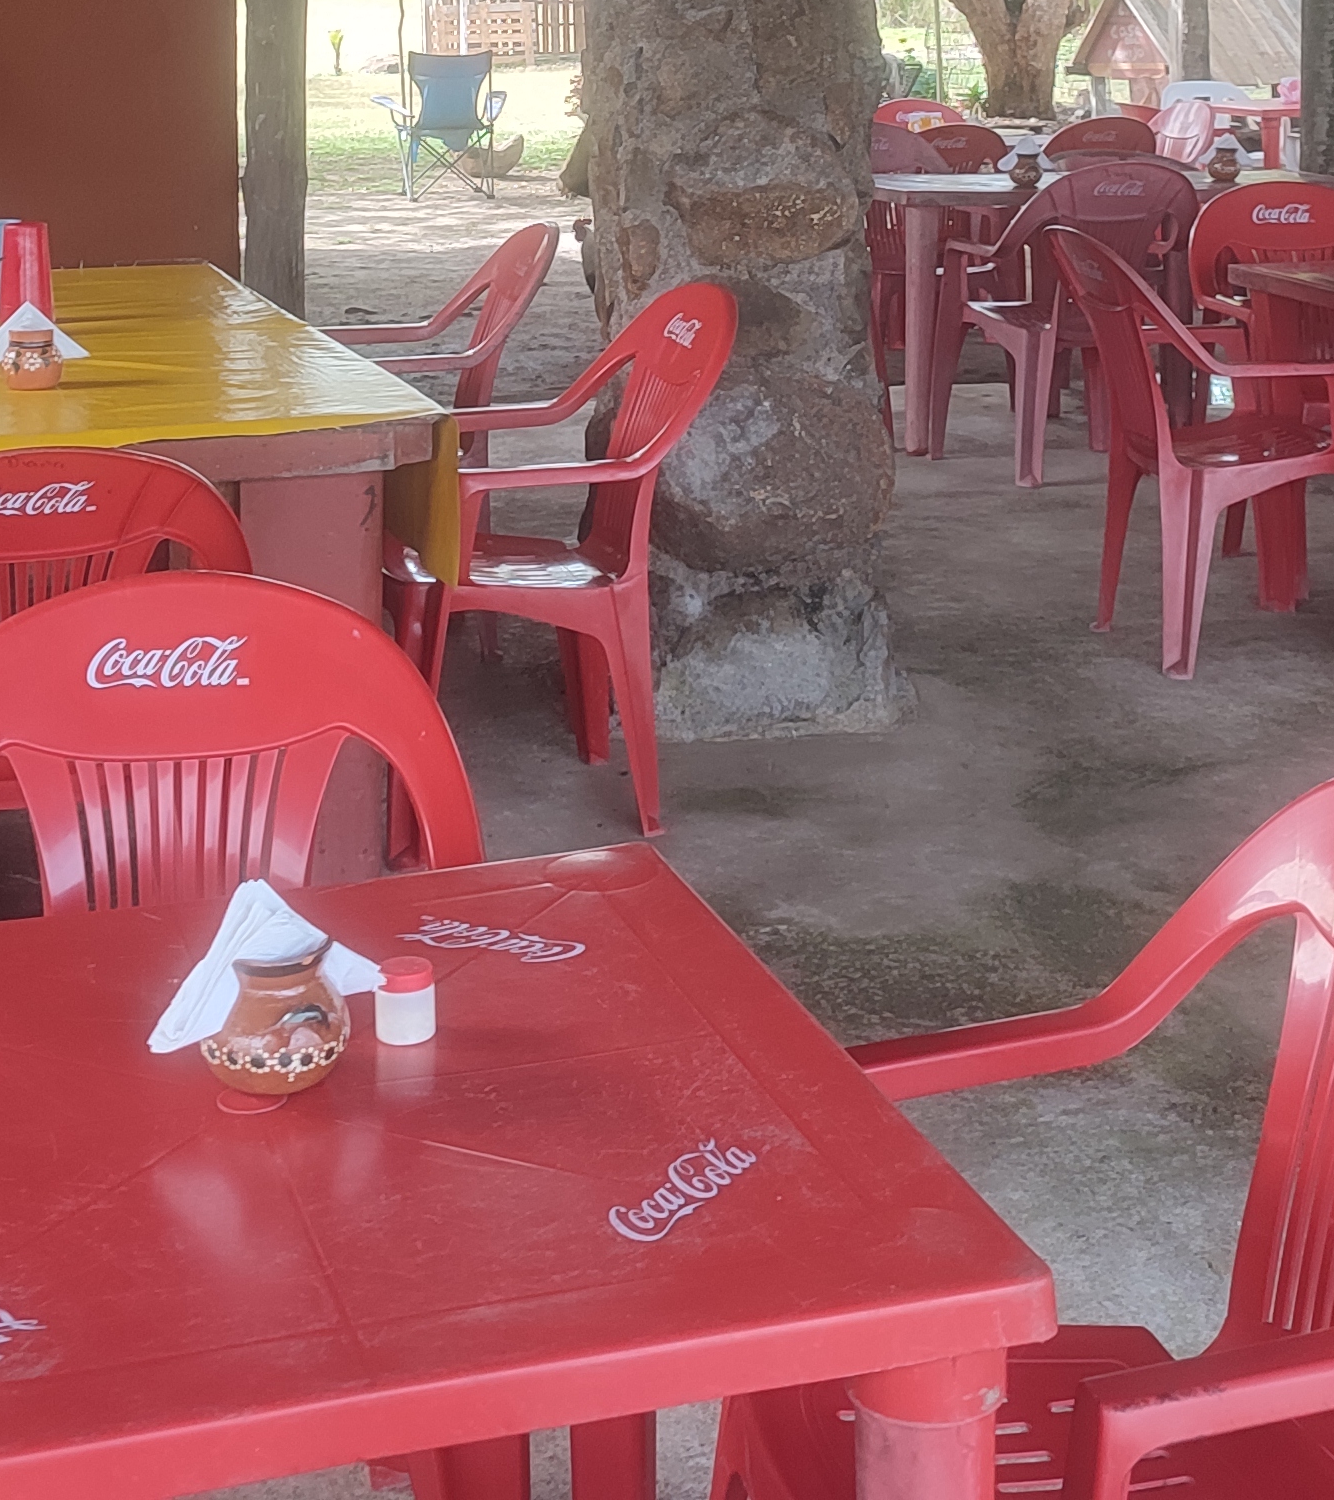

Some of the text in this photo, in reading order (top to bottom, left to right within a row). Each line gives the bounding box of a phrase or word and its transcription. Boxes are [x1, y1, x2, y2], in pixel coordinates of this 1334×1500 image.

[1093, 180, 1145, 196] Coca-Cola
[1252, 203, 1312, 225] Coca-Cola
[663, 312, 702, 348] Coca-Cola
[86, 635, 249, 689] Coca-Cola
[395, 915, 586, 963] Coca-Cola
[608, 1136, 758, 1242] Coca-Cola
